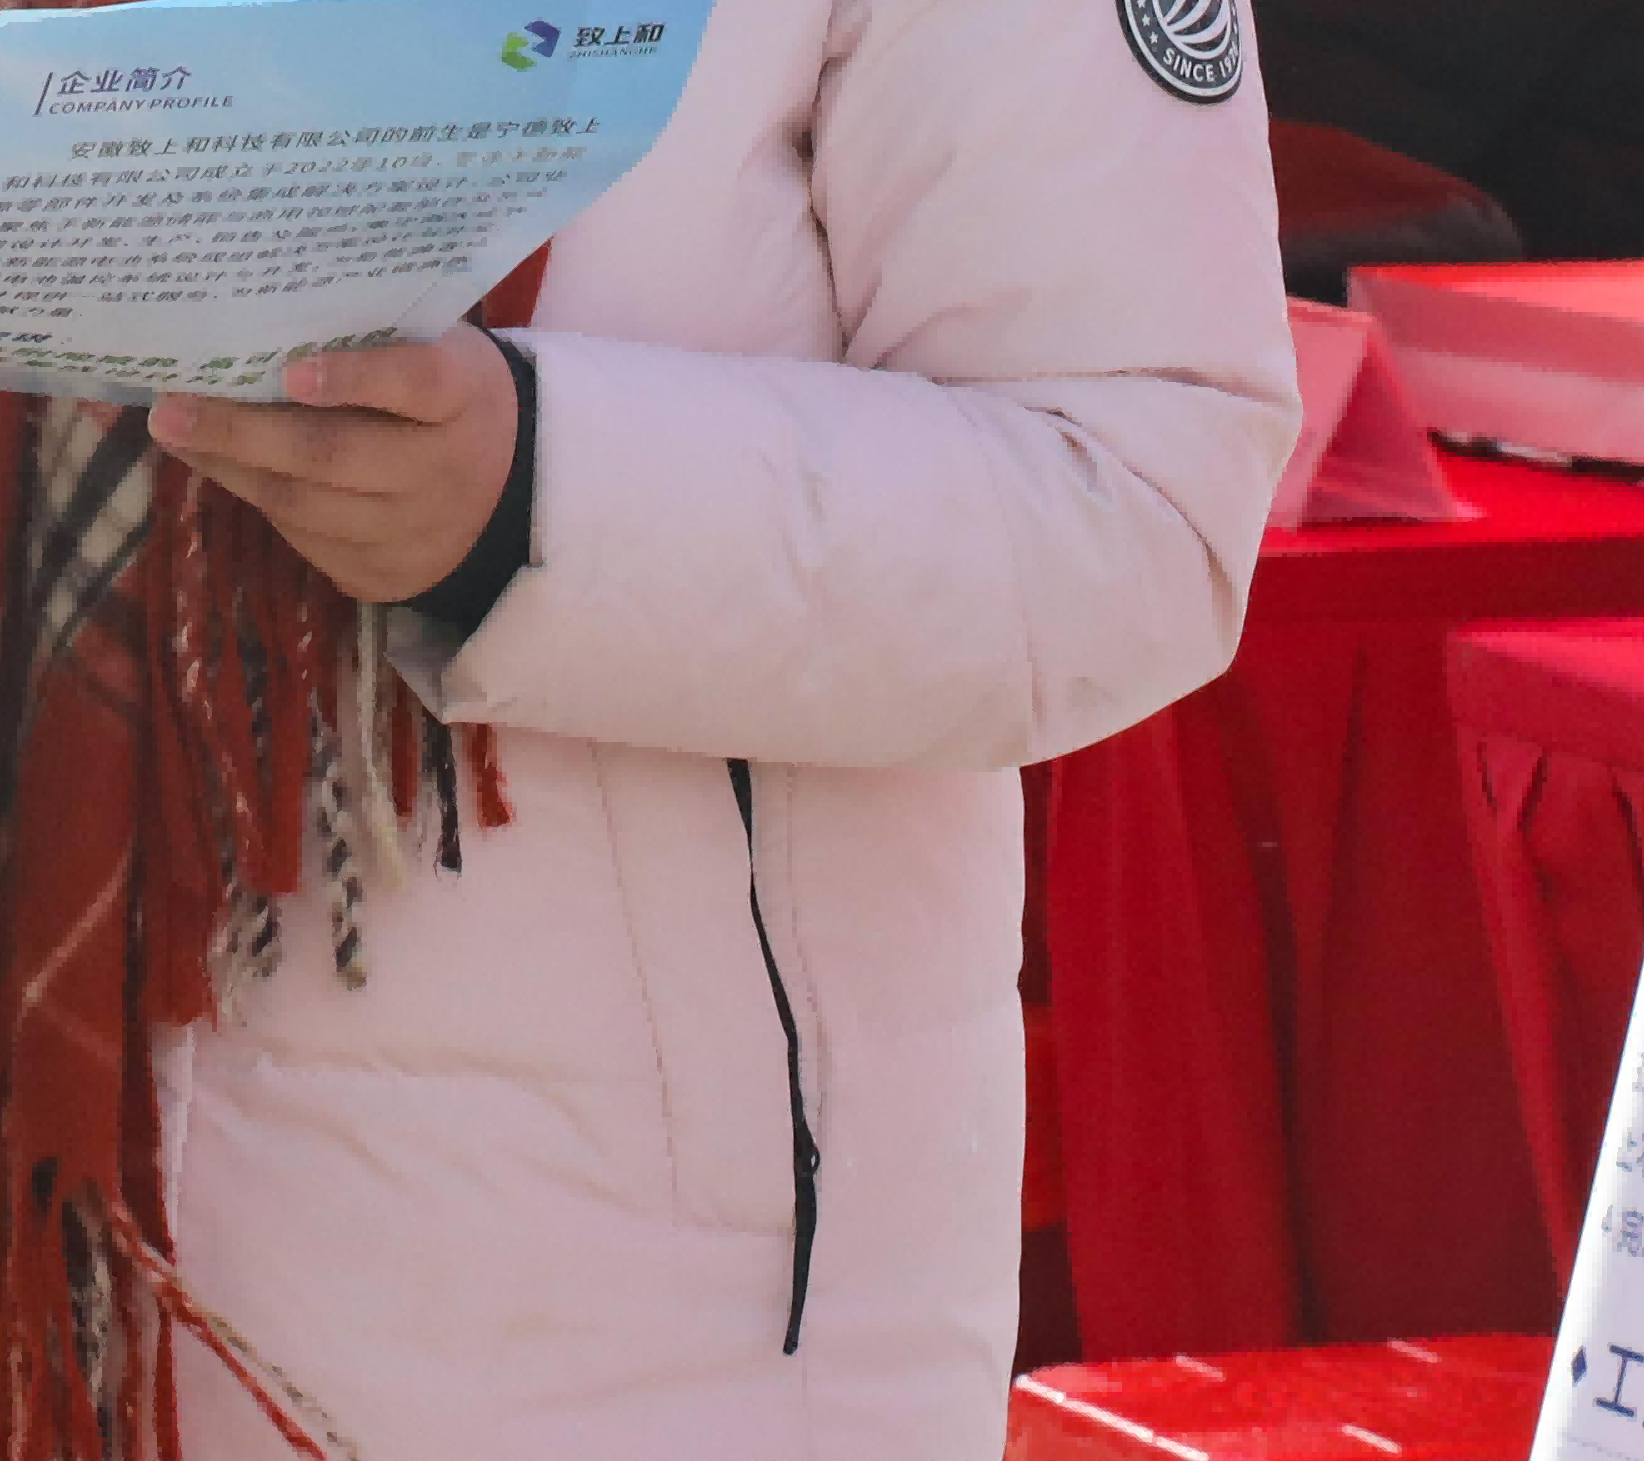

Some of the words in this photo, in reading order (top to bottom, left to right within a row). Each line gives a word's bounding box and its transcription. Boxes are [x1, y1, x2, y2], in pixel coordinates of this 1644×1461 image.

[573, 22, 668, 48] 致上和
[1162, 47, 1216, 83] SINCE
[57, 65, 192, 95] 企业简介
[48, 98, 147, 115] COMPANY
[148, 94, 234, 110] PROFILE
